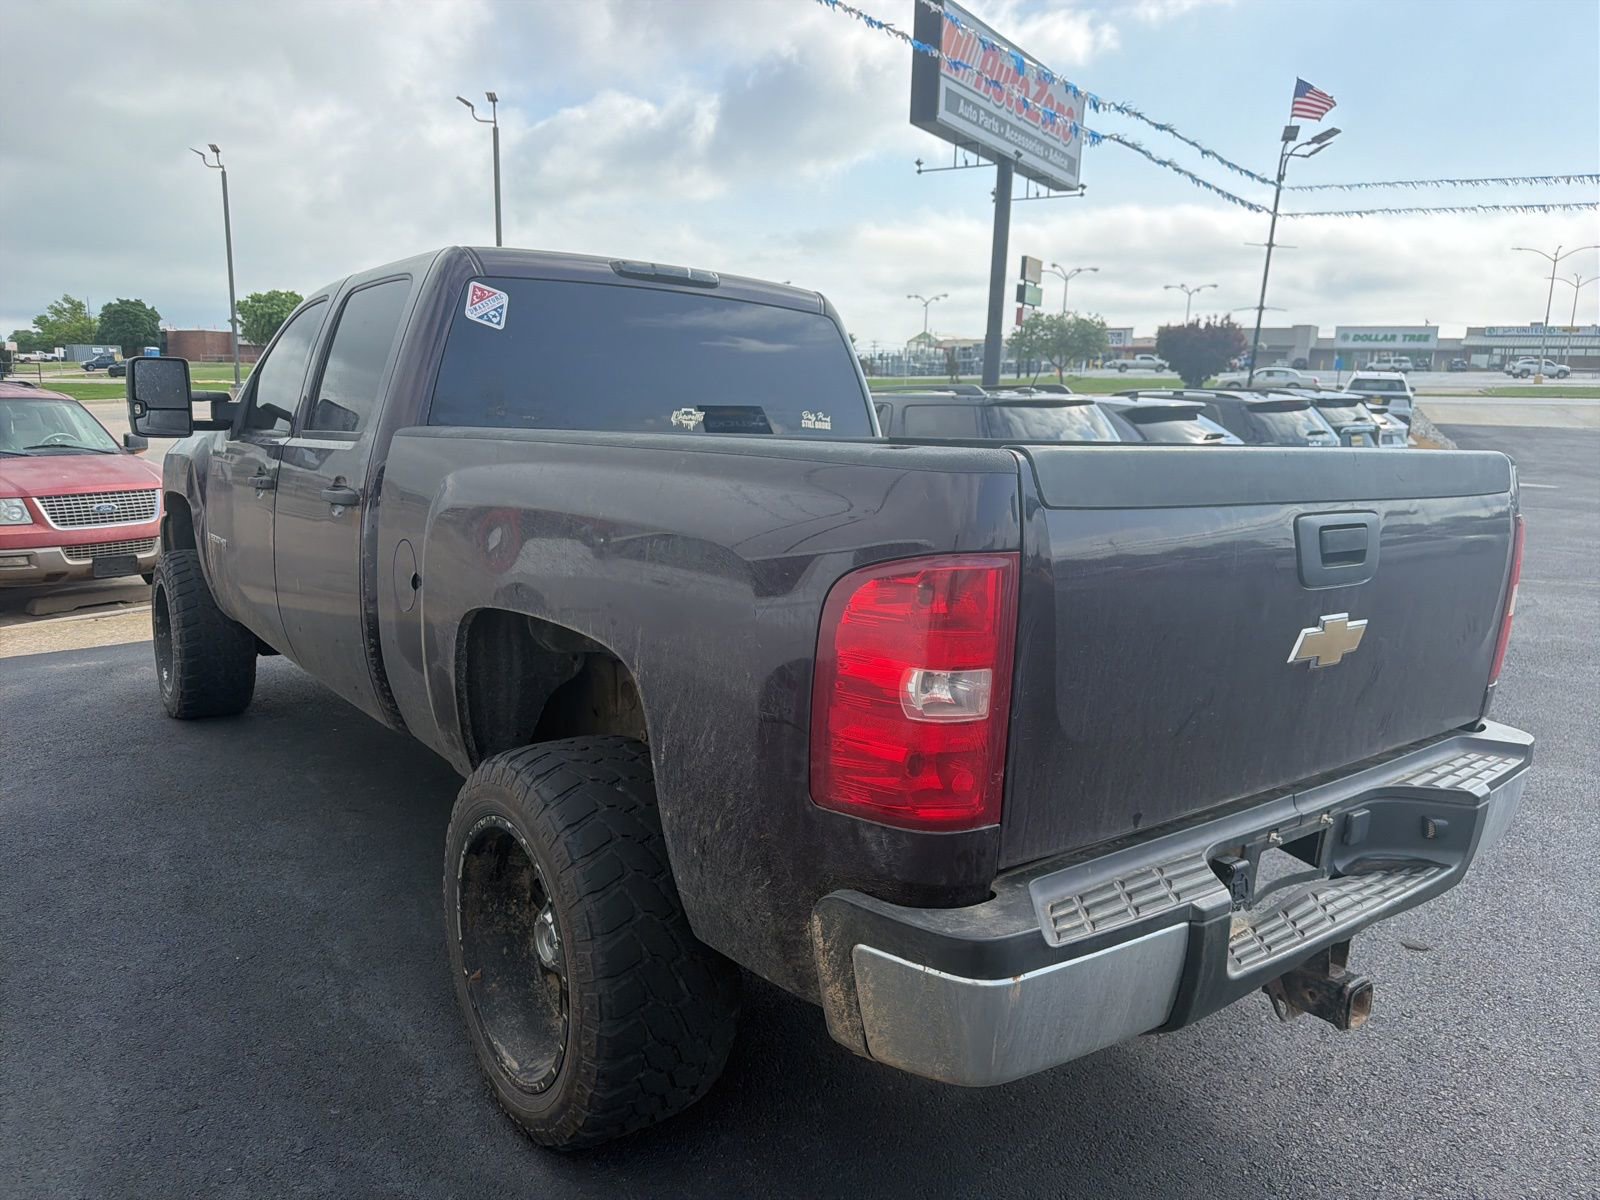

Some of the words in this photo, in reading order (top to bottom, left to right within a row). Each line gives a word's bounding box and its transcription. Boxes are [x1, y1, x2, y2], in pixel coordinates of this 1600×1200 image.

[958, 98, 977, 120] Auto
[979, 110, 999, 134] Parts
[1005, 124, 1044, 157] Accessories
[1352, 333, 1397, 342] DOLLAR
[1402, 333, 1430, 342] TREE
